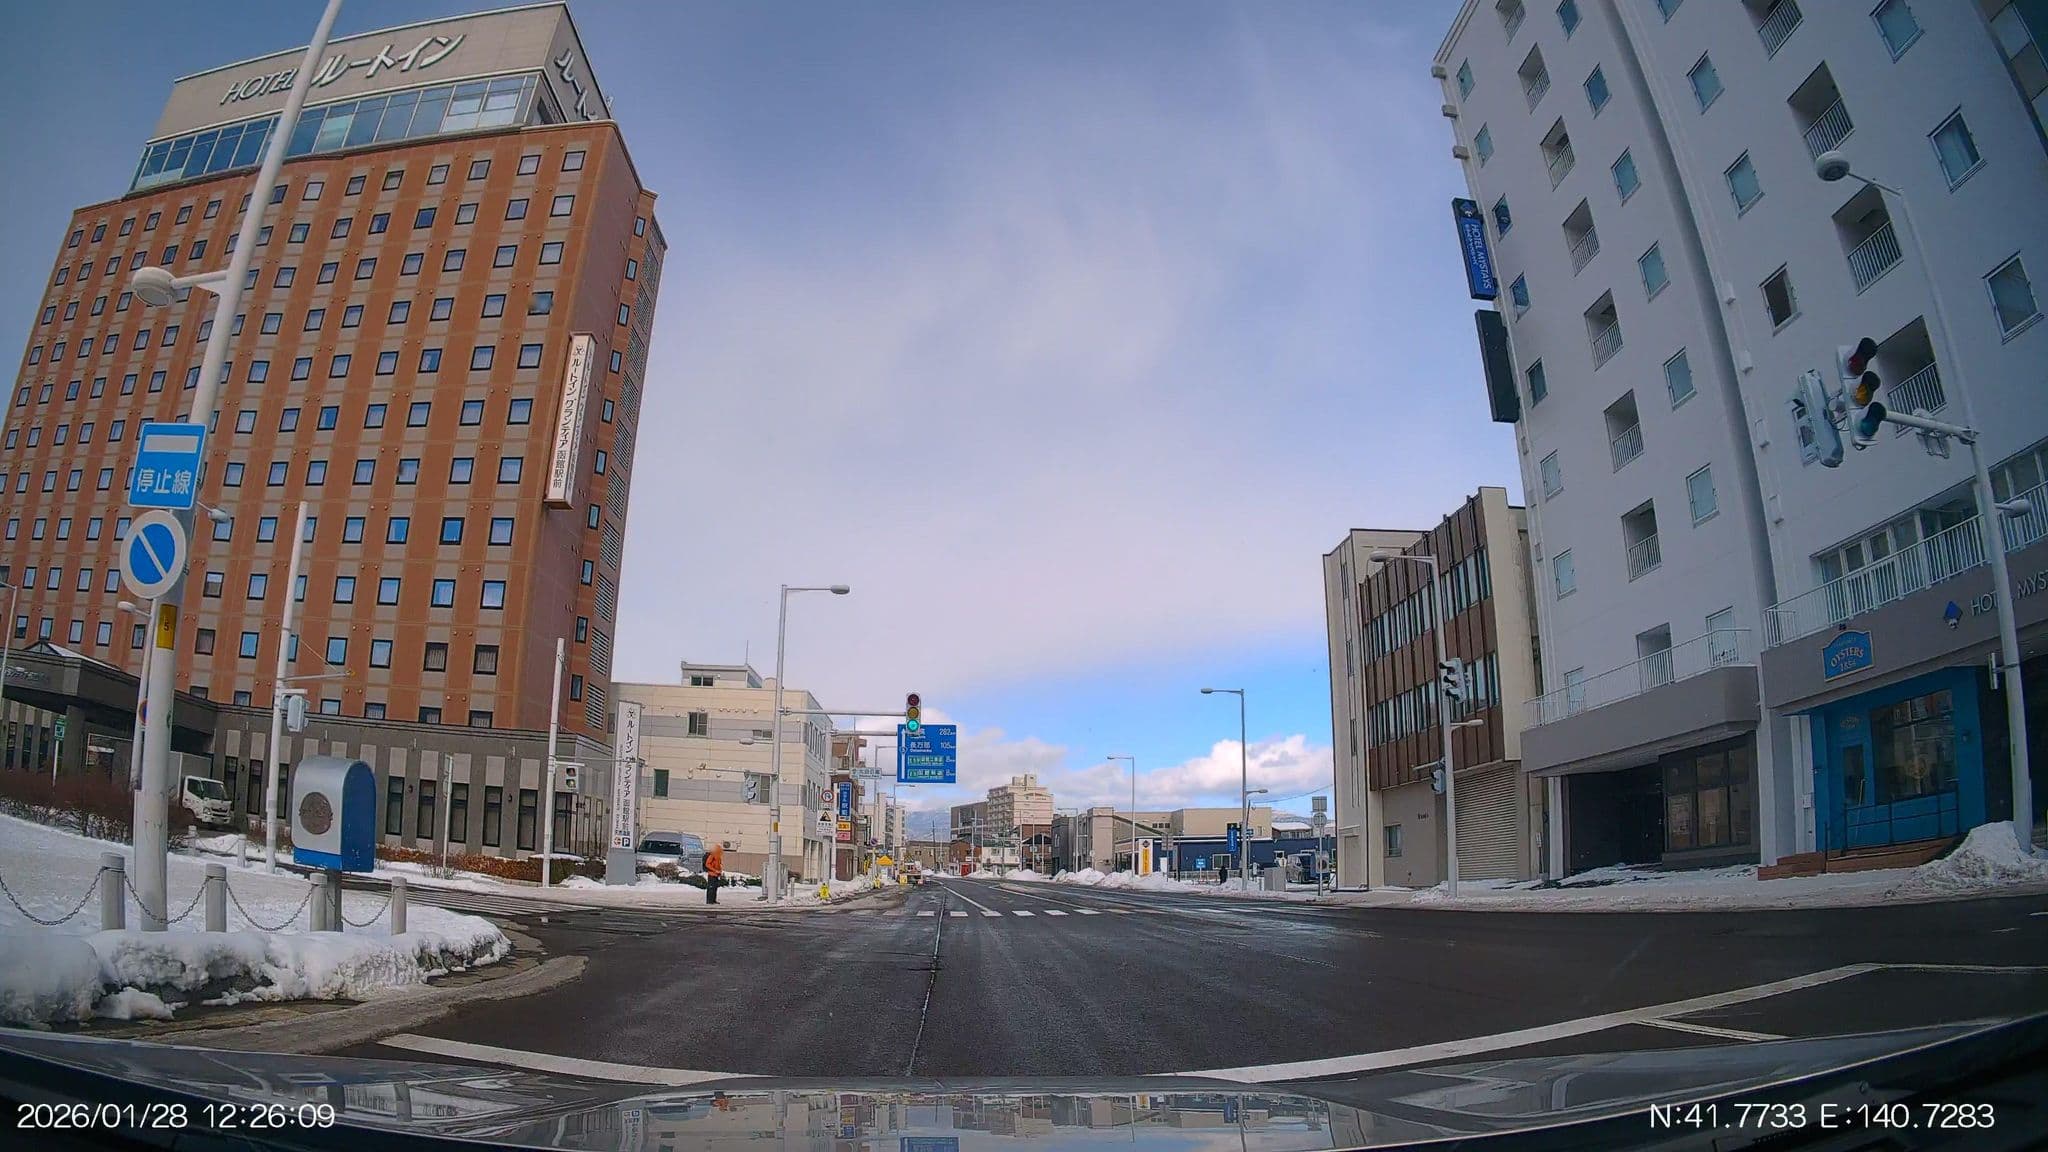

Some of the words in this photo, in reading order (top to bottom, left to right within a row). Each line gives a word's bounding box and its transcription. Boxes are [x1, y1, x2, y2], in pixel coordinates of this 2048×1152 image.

[219, 68, 299, 105] HOTEL
[312, 34, 467, 88] ルートイン
[136, 468, 192, 495] 停止線
[1830, 646, 1864, 668] OYSTERS
